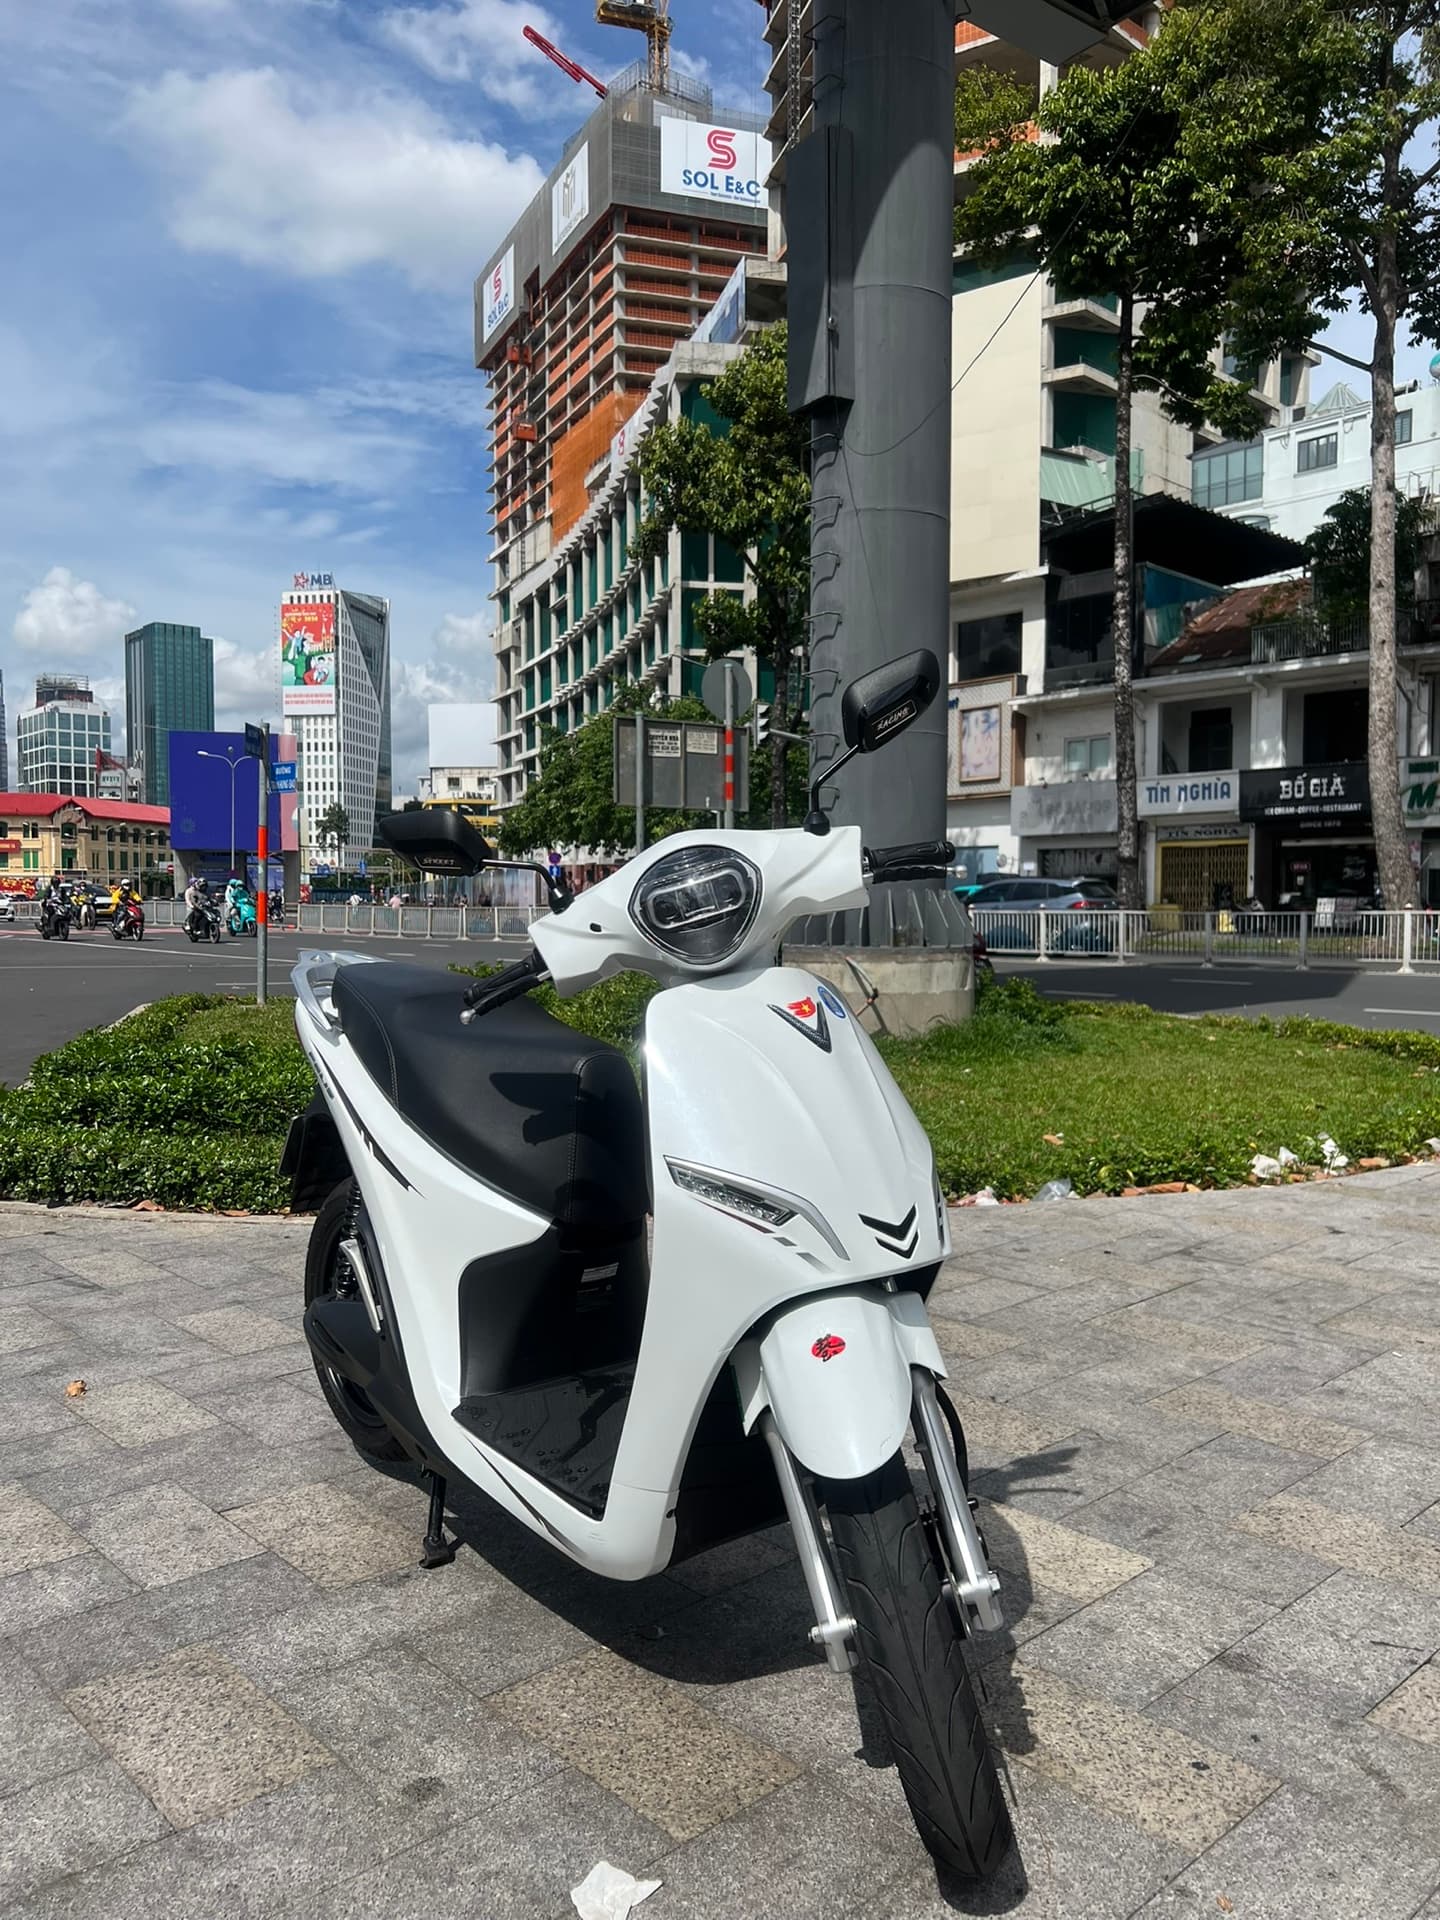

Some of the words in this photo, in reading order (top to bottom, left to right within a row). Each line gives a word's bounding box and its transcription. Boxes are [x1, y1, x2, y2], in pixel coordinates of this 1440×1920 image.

[682, 169, 719, 190] SOL
[725, 175, 761, 197] E&C
[310, 574, 333, 586] MB
[877, 706, 910, 730] RACING
[1146, 782, 1170, 804] TÍN
[1280, 772, 1308, 799] BỐ
[1310, 773, 1345, 797] GIÀ
